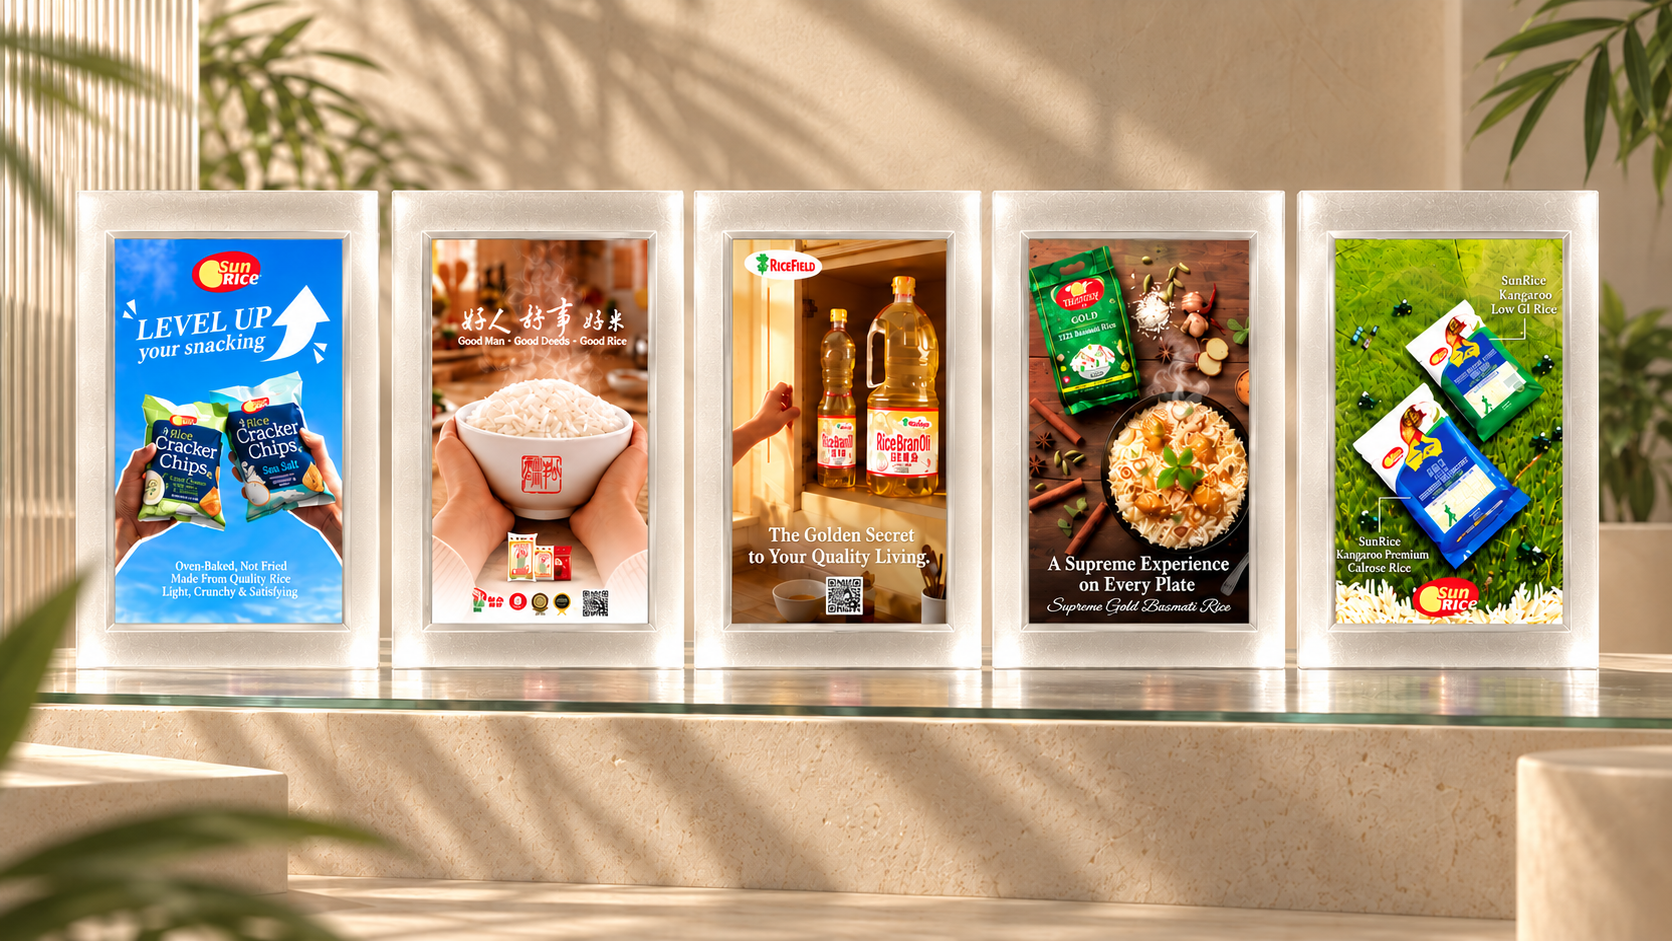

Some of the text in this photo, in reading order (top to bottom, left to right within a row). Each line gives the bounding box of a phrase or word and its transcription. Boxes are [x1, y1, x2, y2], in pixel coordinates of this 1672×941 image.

[218, 260, 251, 274] Sun
[1501, 275, 1546, 286] SunRice
[1499, 289, 1552, 302] Kangaroo
[1491, 304, 1558, 314] Low GI Rice
[136, 306, 272, 340] LEVEL UP
[461, 306, 511, 334] 好人
[583, 308, 624, 332] 好米
[1070, 312, 1098, 324] GOLD
[458, 336, 482, 346] Good
[485, 336, 504, 346] Man
[514, 336, 538, 346] Good
[542, 336, 570, 346] Deeds
[580, 336, 605, 346] Good
[608, 336, 628, 346] Rice
[138, 333, 266, 364] your snacking
[236, 422, 298, 444] Cracker
[156, 436, 218, 459] Cracker
[248, 440, 298, 459] Chips
[160, 453, 208, 476] Chips
[280, 460, 300, 472] Salt
[768, 527, 915, 542] The Golden Secret
[1358, 536, 1402, 546] SunRice
[748, 548, 930, 568] to Your Quality Living.
[1336, 550, 1430, 562] Kangaroo Premium
[175, 560, 288, 572] Oven-Baked, Not Fried
[1048, 556, 1230, 575] A Supreme Experience
[1348, 562, 1412, 573] Calrose Rice
[171, 573, 291, 586] Made From Quality Rice
[1079, 576, 1196, 596] on Every Plate
[162, 586, 298, 599] Light, Crunchy & Satisfying
[1437, 586, 1470, 599] Sun
[1047, 597, 1232, 616] Supreme Gold Basmati Rice
